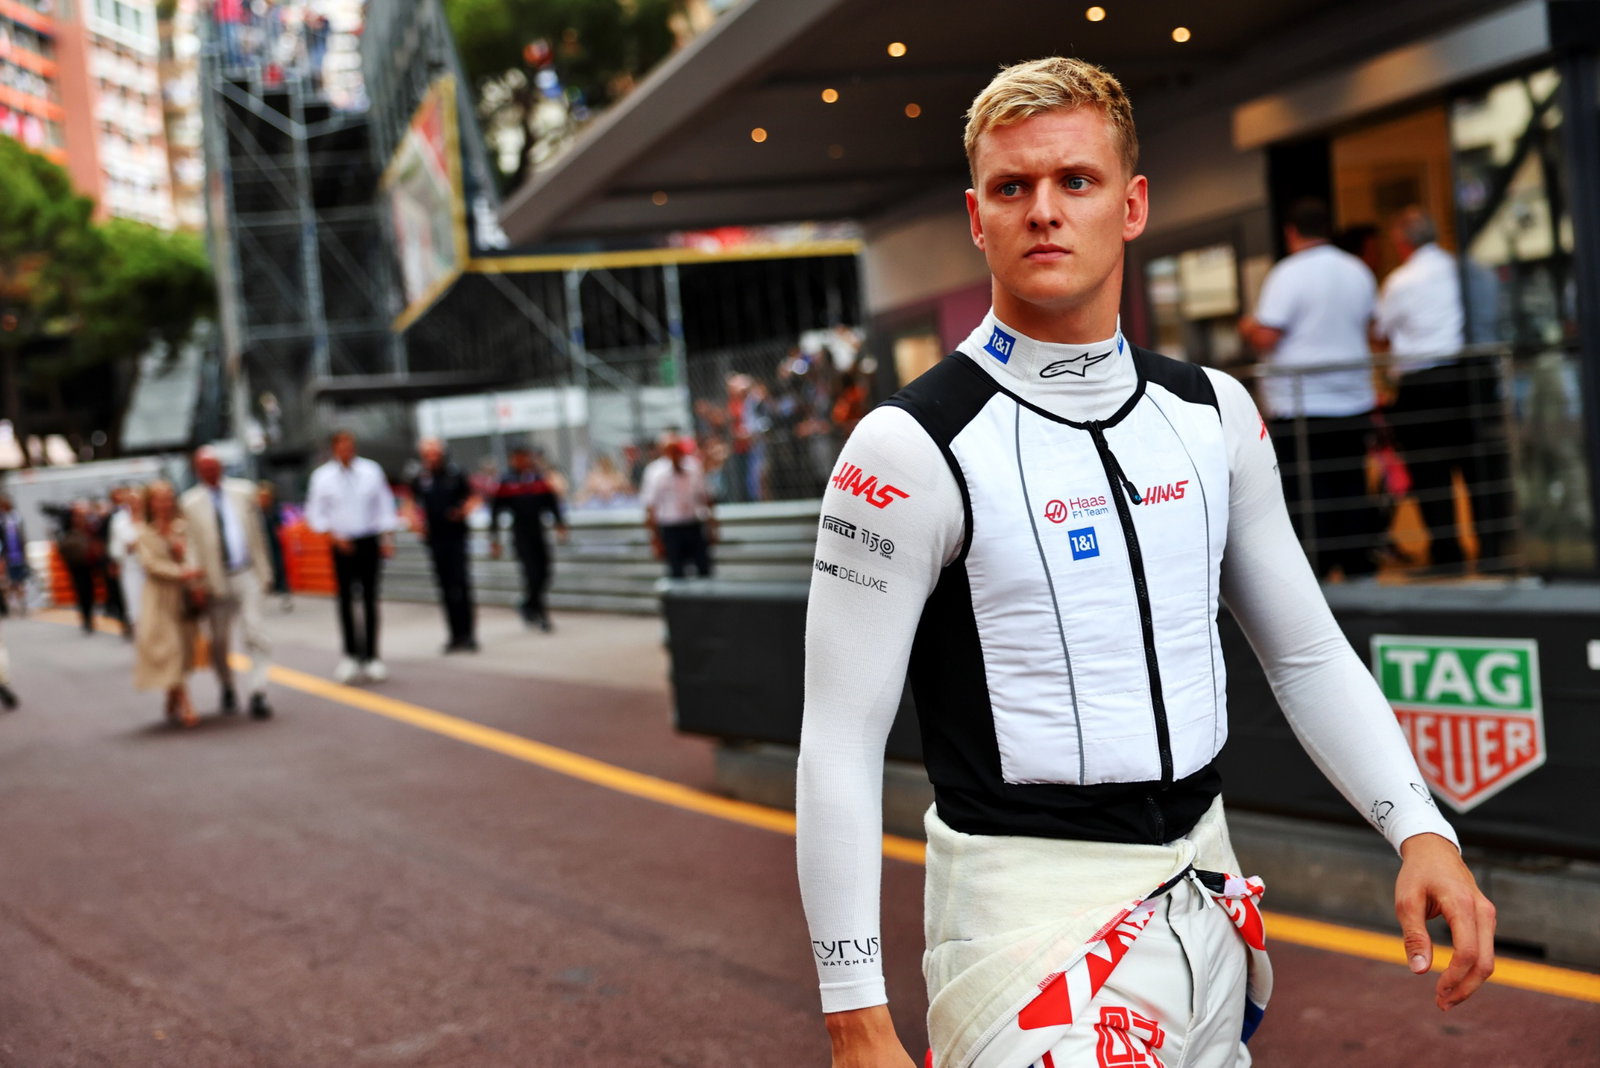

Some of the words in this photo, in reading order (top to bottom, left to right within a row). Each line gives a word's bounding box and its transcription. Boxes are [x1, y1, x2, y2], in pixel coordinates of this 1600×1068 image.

[991, 332, 1011, 356] 1&1
[832, 462, 910, 509] HAAS
[1141, 480, 1189, 506] HAAS
[1069, 495, 1107, 510] Haas
[1072, 510, 1084, 519] F1
[1085, 507, 1109, 517] Team
[822, 515, 857, 539] PIRELLI
[861, 528, 895, 555] 150
[1071, 533, 1096, 553] 1&1
[1385, 650, 1524, 706] TAG
[822, 957, 875, 967] WATCHES
